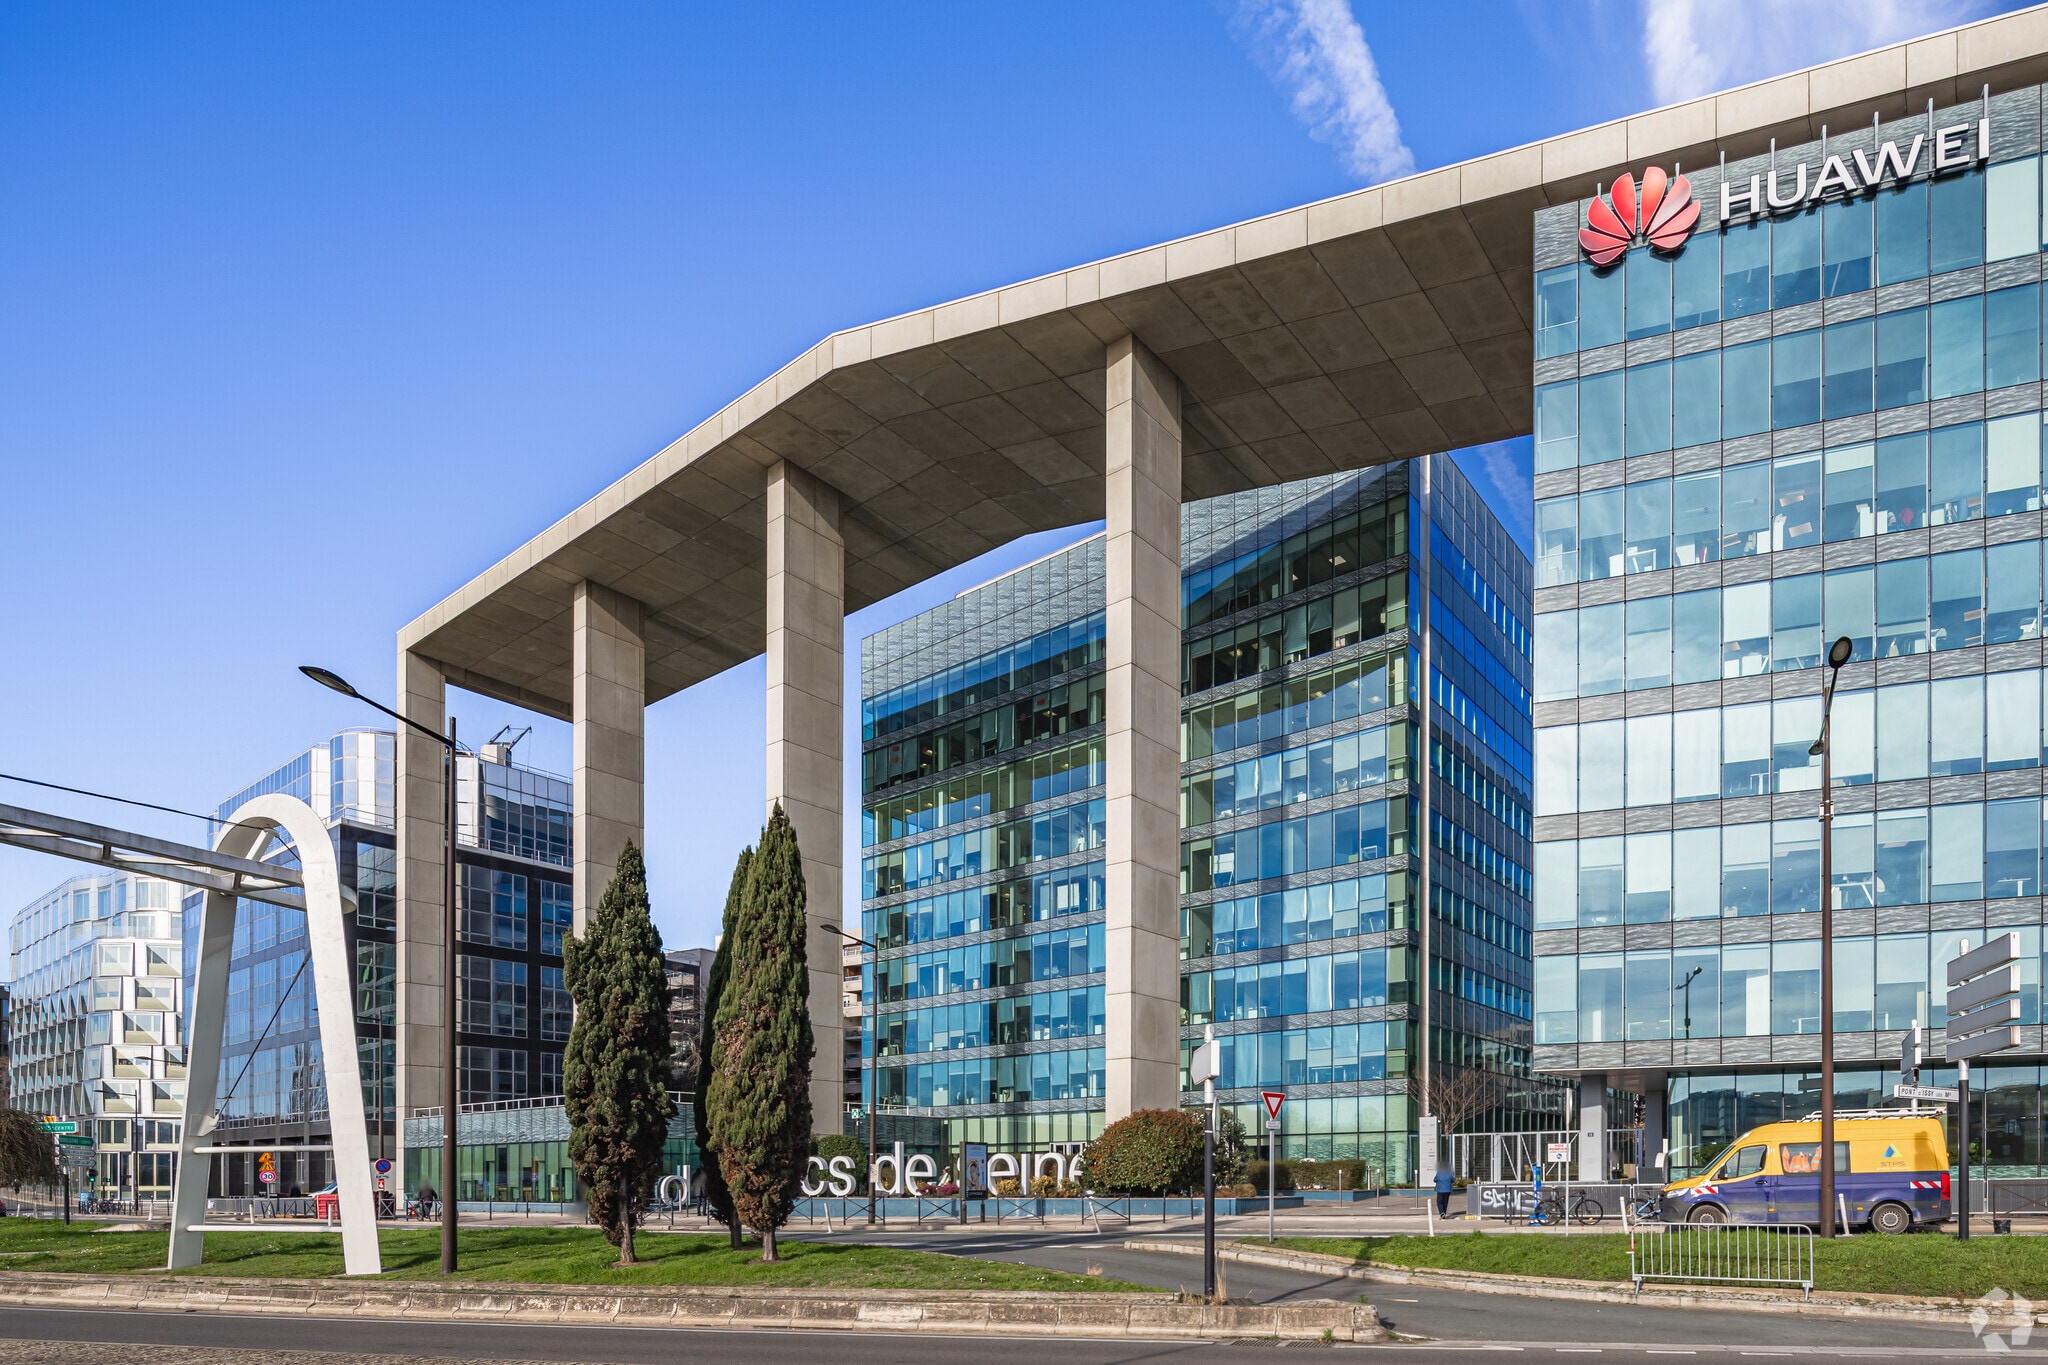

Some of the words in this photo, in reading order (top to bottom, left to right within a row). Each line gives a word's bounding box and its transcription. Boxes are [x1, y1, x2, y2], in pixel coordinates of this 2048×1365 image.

[1720, 118, 1990, 221] HUAWEI
[801, 1157, 856, 1196] cs
[875, 1142, 937, 1196] de
[957, 1152, 1094, 1197] eine
